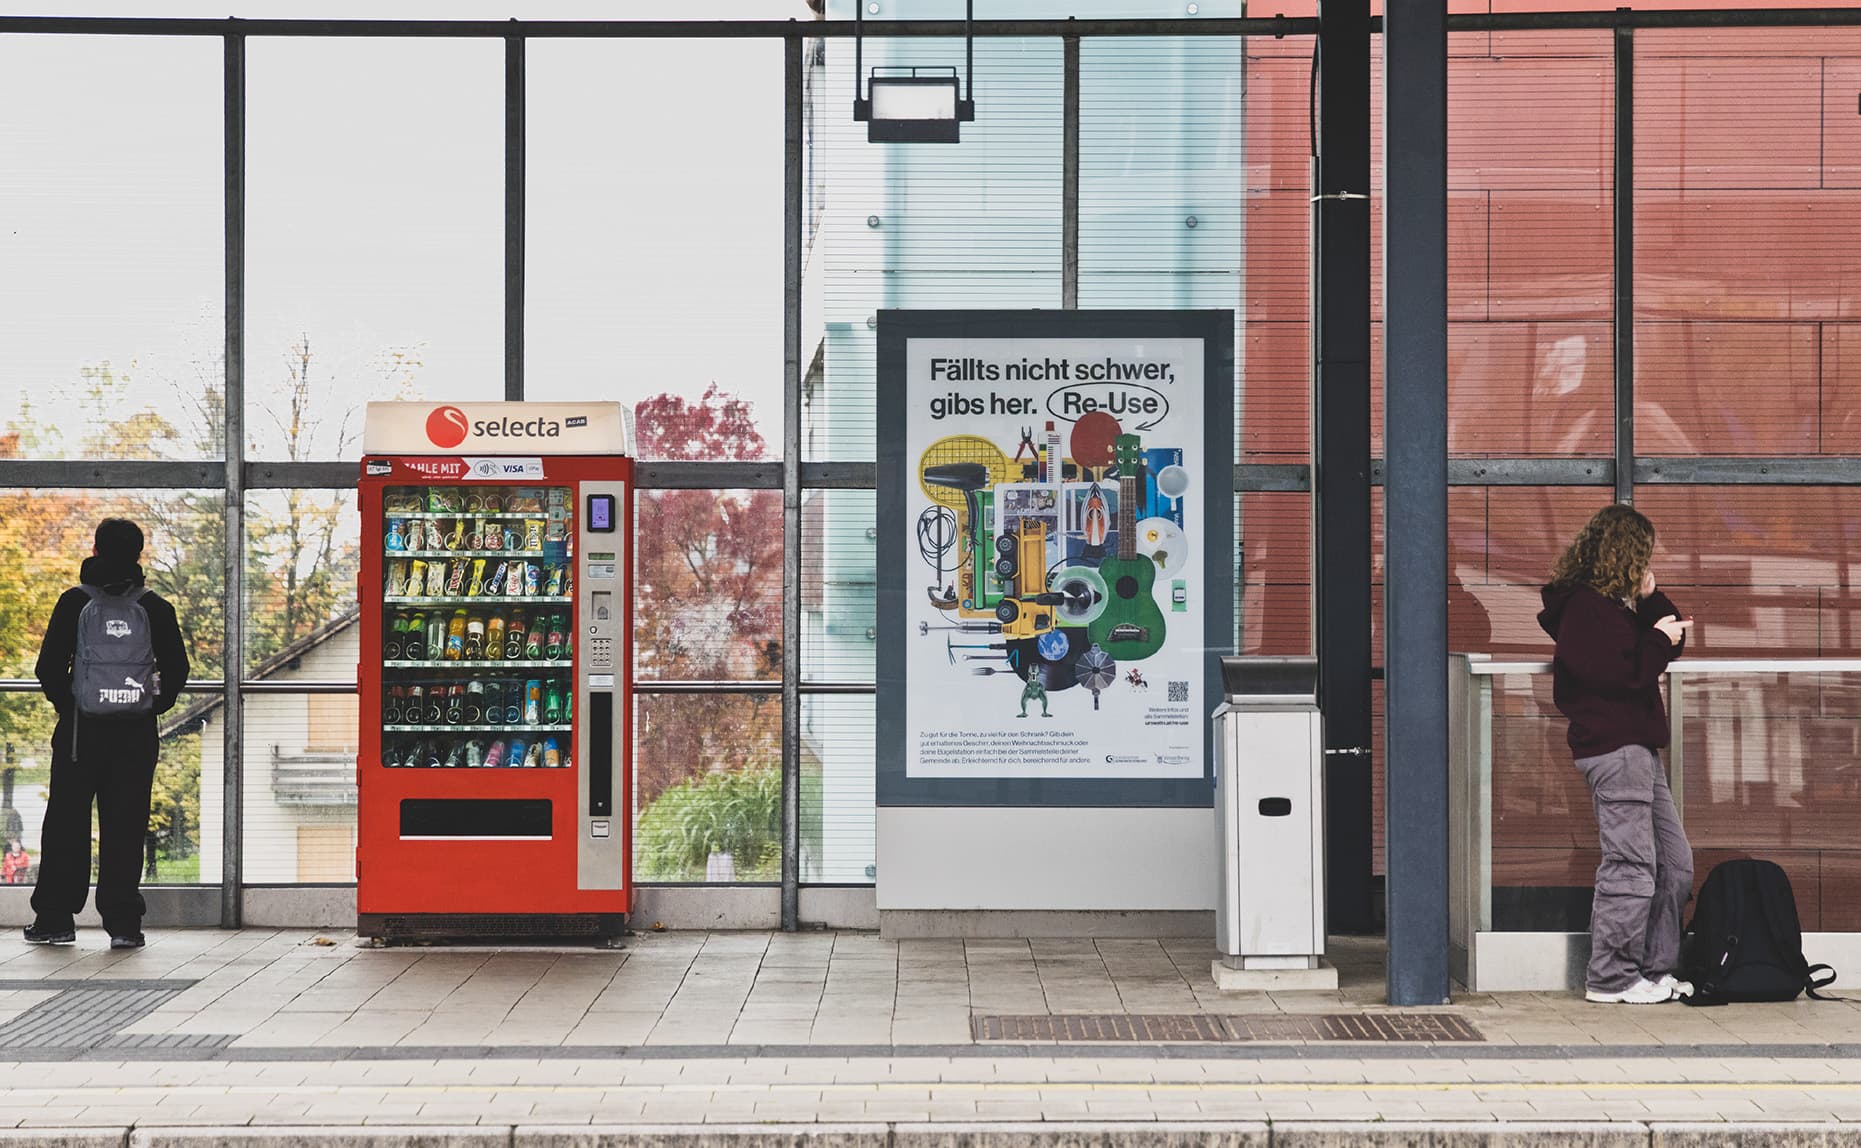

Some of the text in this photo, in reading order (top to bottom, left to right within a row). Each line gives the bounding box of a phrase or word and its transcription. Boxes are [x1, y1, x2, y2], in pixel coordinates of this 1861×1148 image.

[931, 358, 1175, 384] Fällts nicht schwer,
[930, 391, 1159, 420] gibs her. Re-Use
[472, 417, 560, 437] selecta
[440, 463, 462, 474] MIT
[503, 465, 524, 473] VISA
